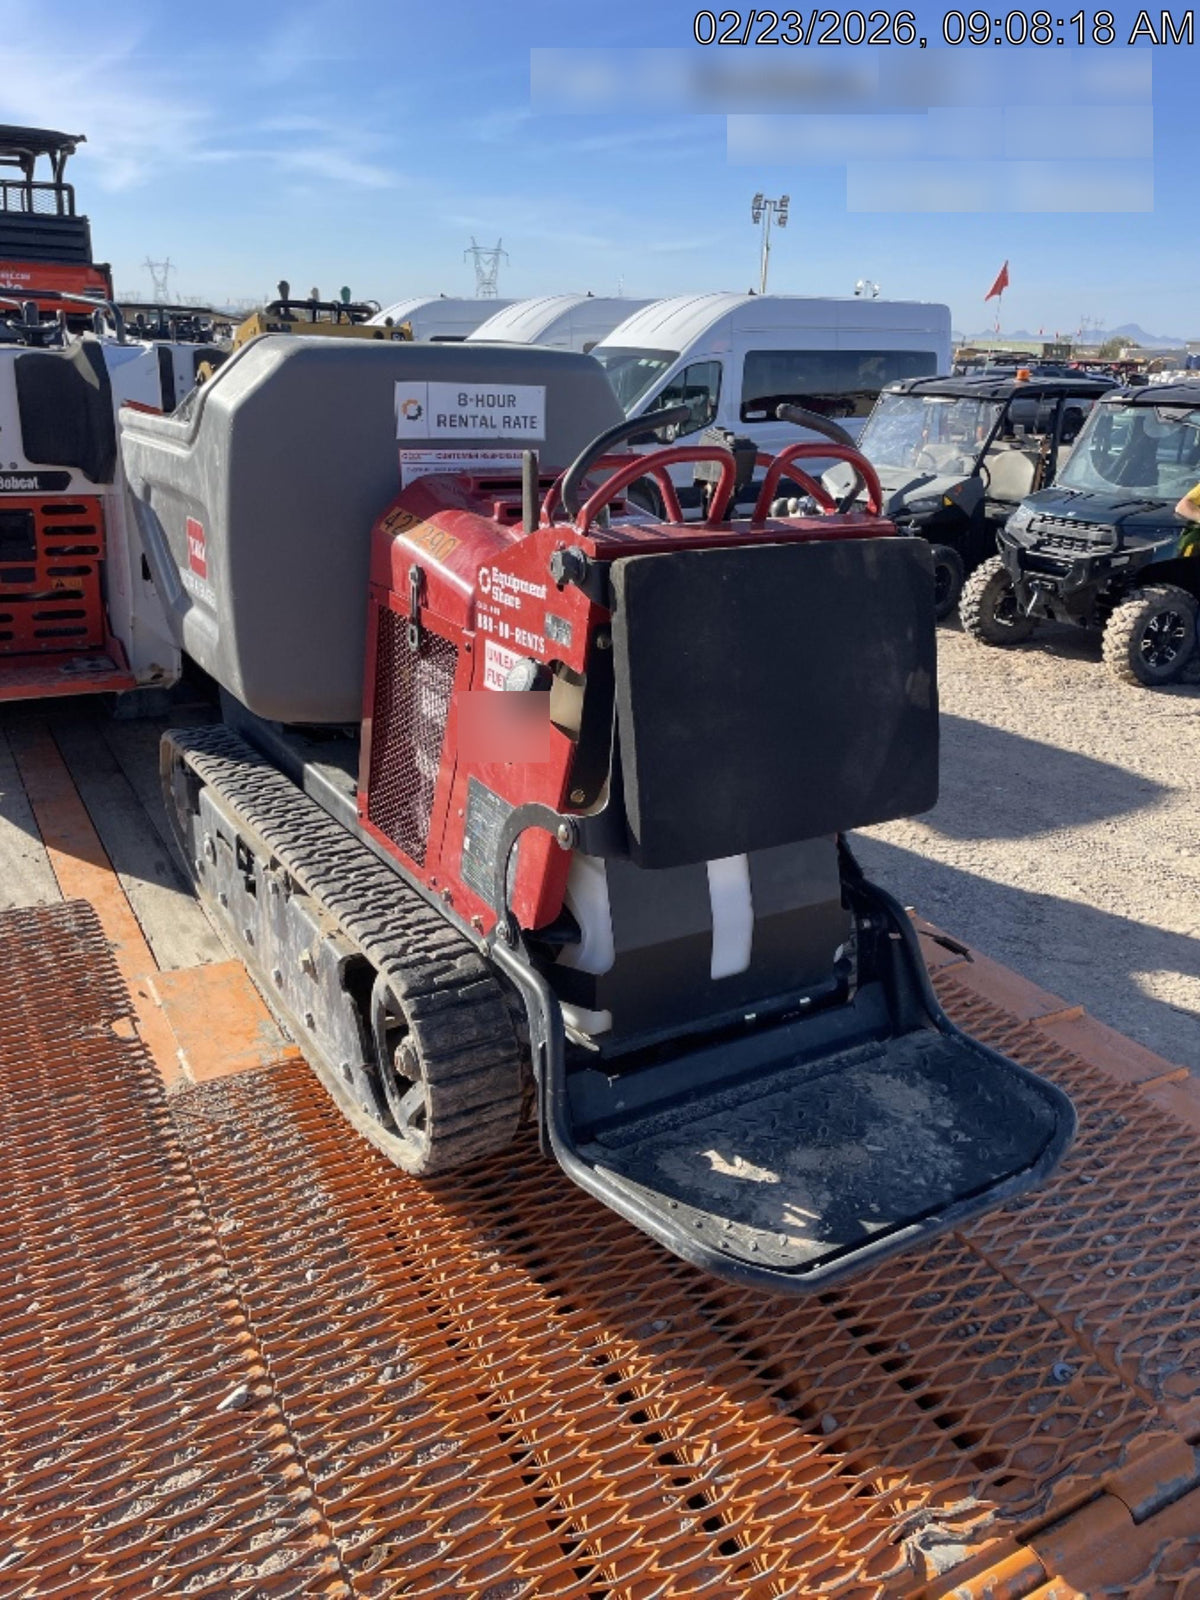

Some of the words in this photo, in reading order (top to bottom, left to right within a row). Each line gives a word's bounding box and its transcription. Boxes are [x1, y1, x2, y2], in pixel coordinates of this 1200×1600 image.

[457, 392, 516, 408] 8-HOUR
[436, 414, 497, 429] RENTAL
[502, 415, 538, 429] RATE
[492, 566, 547, 600] Equipment
[492, 585, 521, 609] Share
